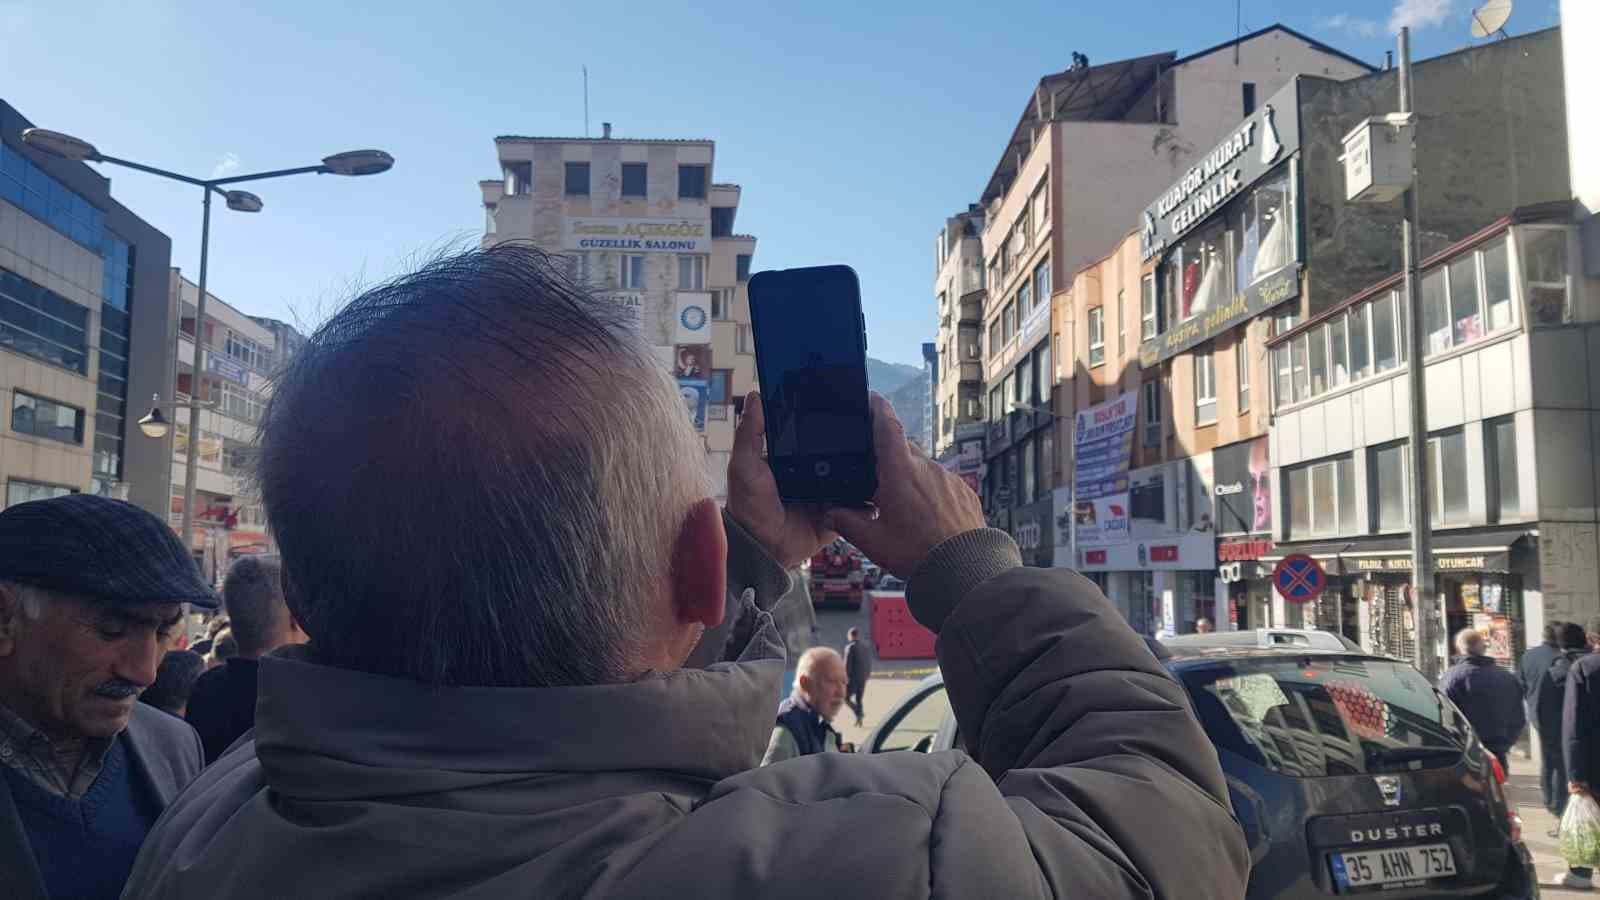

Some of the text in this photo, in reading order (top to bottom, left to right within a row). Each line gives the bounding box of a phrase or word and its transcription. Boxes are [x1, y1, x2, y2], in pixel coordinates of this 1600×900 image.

[1157, 122, 1257, 219] KUAFÖR MURAT
[1171, 169, 1241, 235] GELİNLİK
[645, 239, 697, 250] SALONU
[1388, 558, 1414, 569] KIRTA
[1438, 556, 1485, 569] OYUNCAK
[1351, 823, 1443, 842] DUSTER
[1346, 847, 1453, 881] 35 AHN 752
